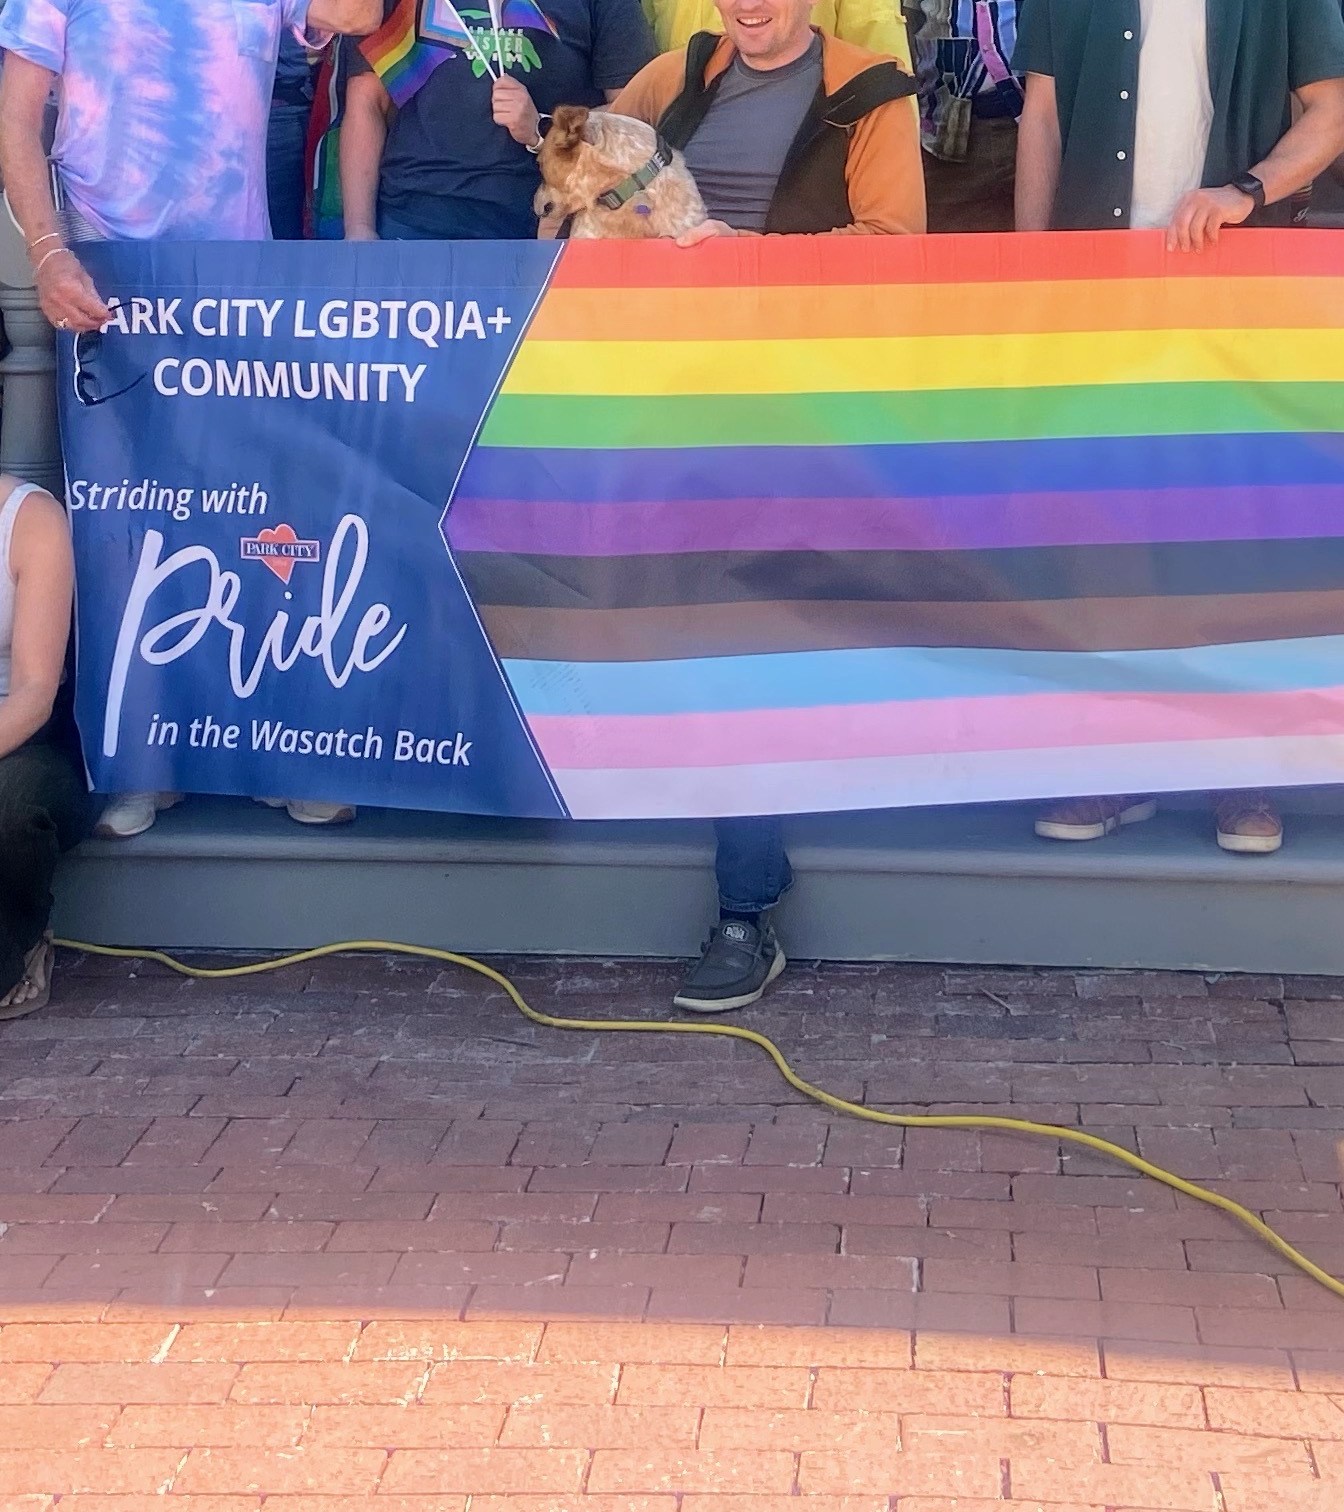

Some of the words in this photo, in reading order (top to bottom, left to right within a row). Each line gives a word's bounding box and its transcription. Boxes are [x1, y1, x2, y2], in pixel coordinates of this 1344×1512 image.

[100, 296, 183, 335] ARK
[192, 298, 284, 337] CITY
[294, 299, 512, 348] LGBTQIA+
[153, 357, 427, 403] COMMUNITY
[71, 478, 194, 521] Striding
[201, 482, 268, 514] with
[246, 542, 279, 555] PARK
[281, 544, 314, 557] CITY
[147, 714, 179, 746] in
[188, 716, 241, 749] the
[251, 720, 383, 760] Wasatch
[393, 730, 473, 767] Back
